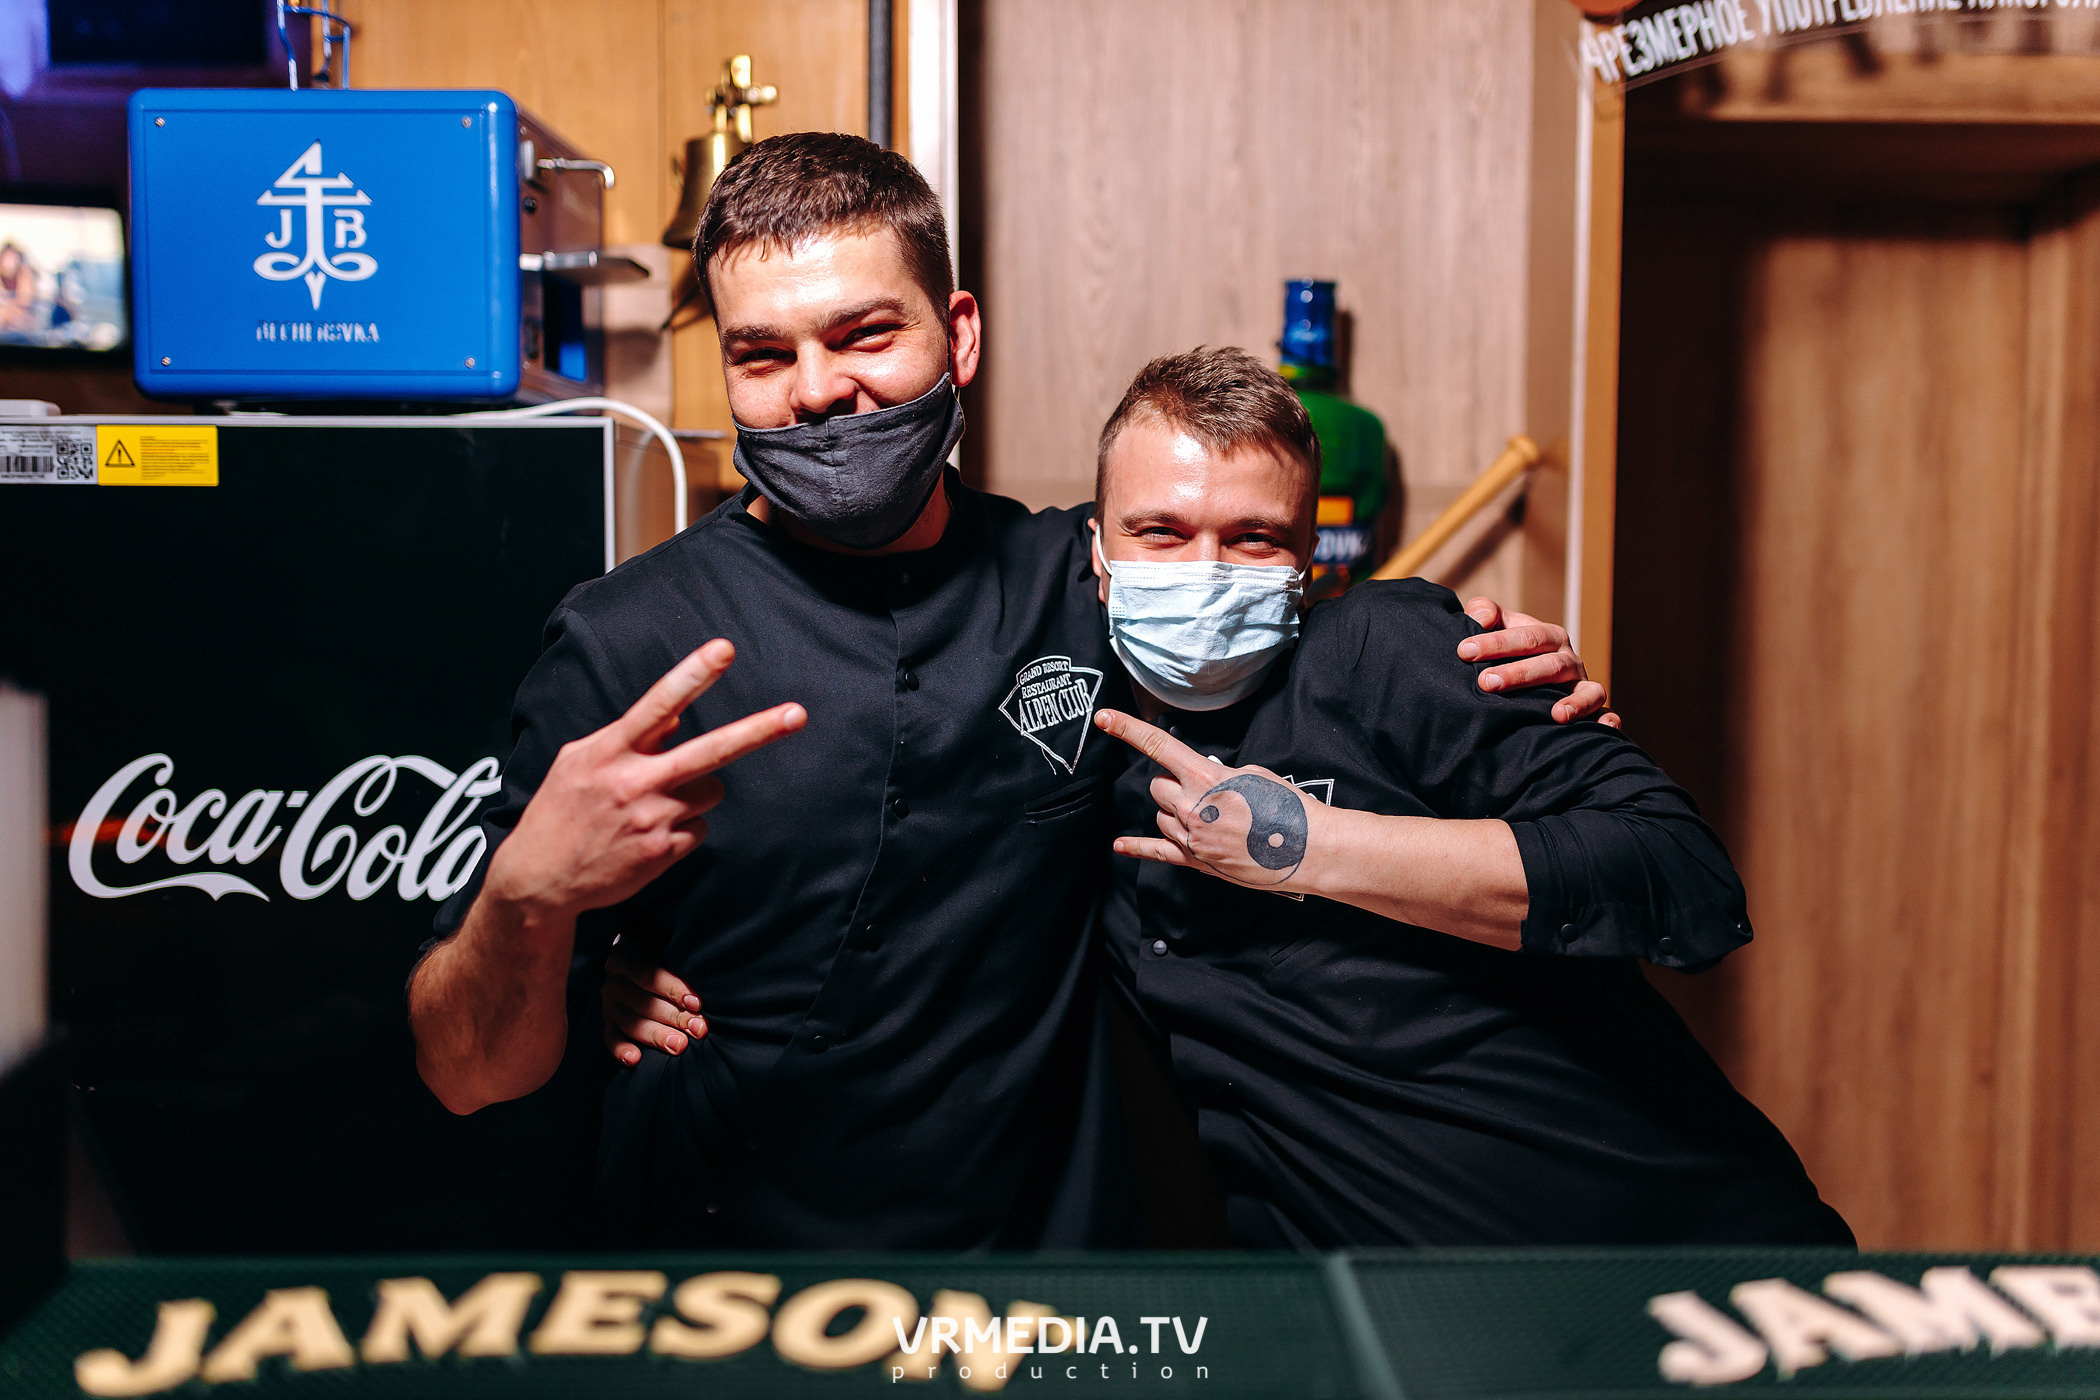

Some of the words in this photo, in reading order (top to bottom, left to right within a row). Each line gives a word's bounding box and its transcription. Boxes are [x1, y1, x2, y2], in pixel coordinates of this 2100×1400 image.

[1020, 665, 1042, 685] GRAND
[1042, 661, 1069, 674] RESORT
[1021, 673, 1072, 699] RESTAURANT
[1018, 693, 1063, 735] ALPEN
[1058, 678, 1093, 721] CLUB
[73, 1268, 1060, 1399] JAMESON
